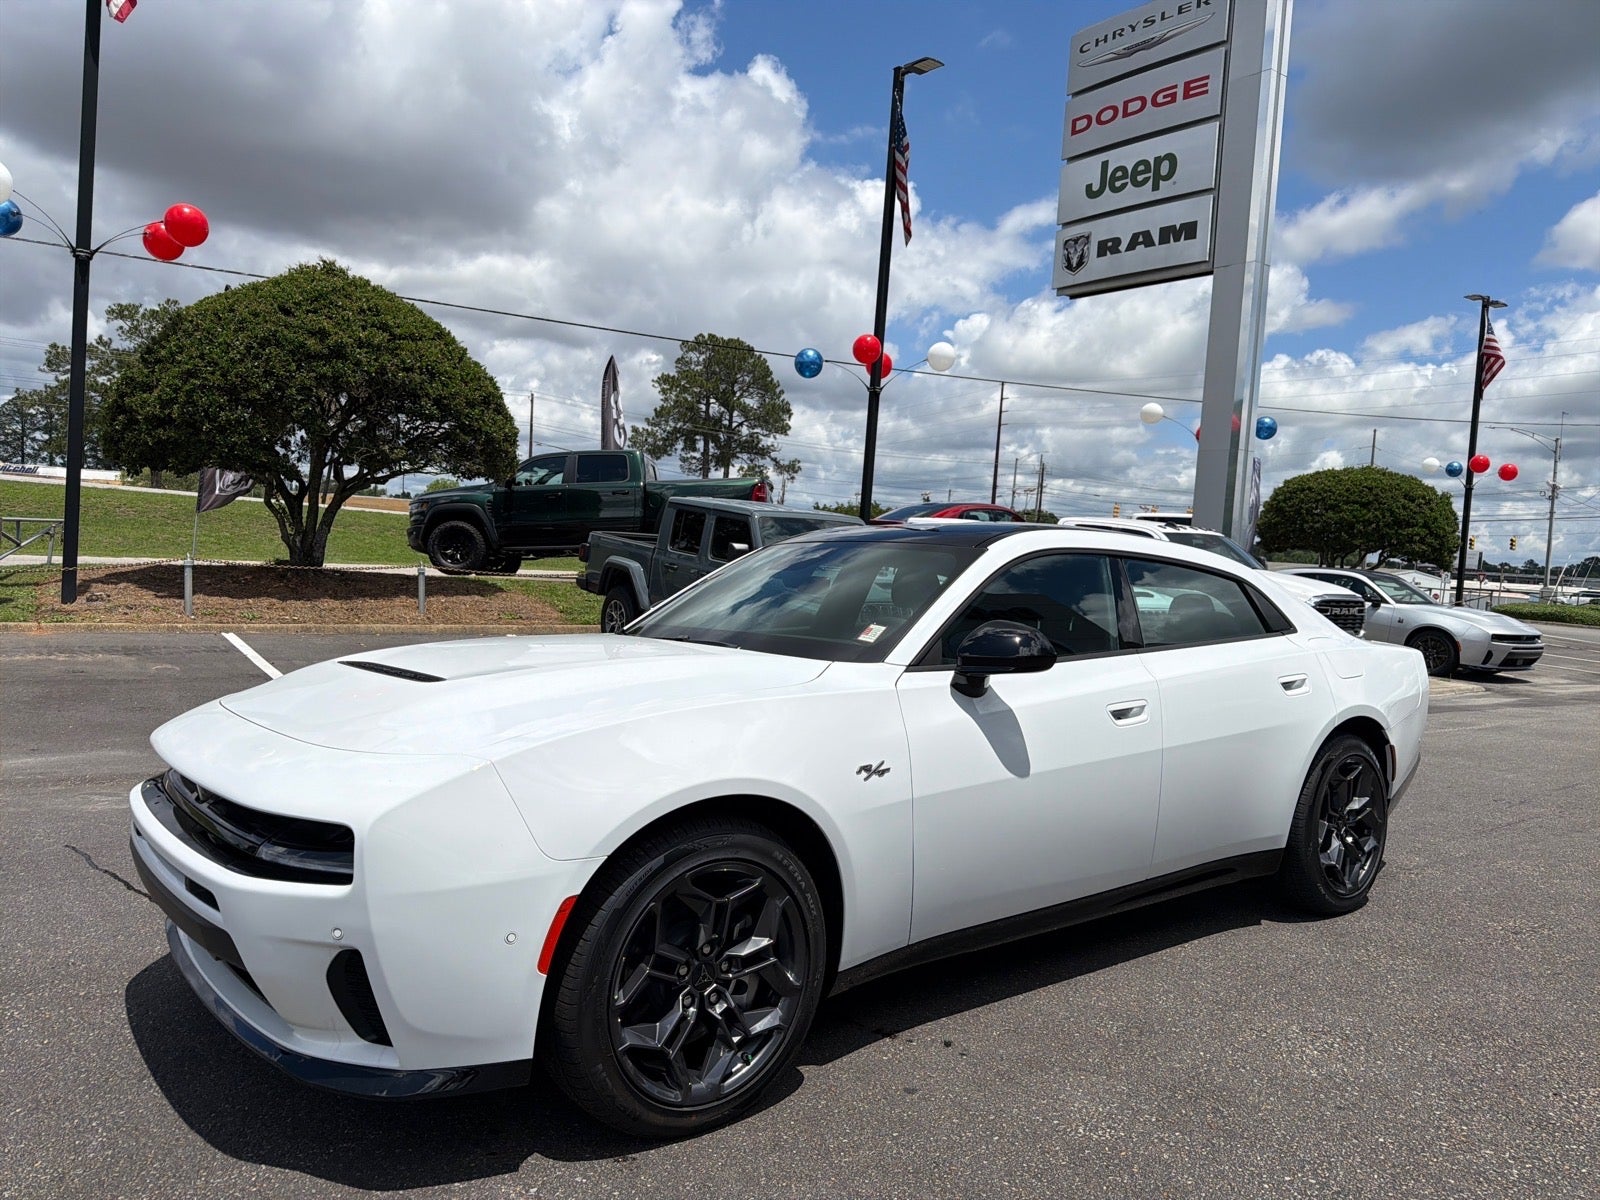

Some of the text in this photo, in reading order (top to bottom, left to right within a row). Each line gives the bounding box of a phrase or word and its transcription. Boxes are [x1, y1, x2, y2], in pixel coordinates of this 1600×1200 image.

[1079, 0, 1212, 54] CHRYSLER
[1070, 74, 1211, 137] DODGE
[1085, 152, 1178, 200] Jeep
[1096, 220, 1199, 259] RAM
[1331, 607, 1358, 616] RAM
[856, 760, 891, 782] R/T
